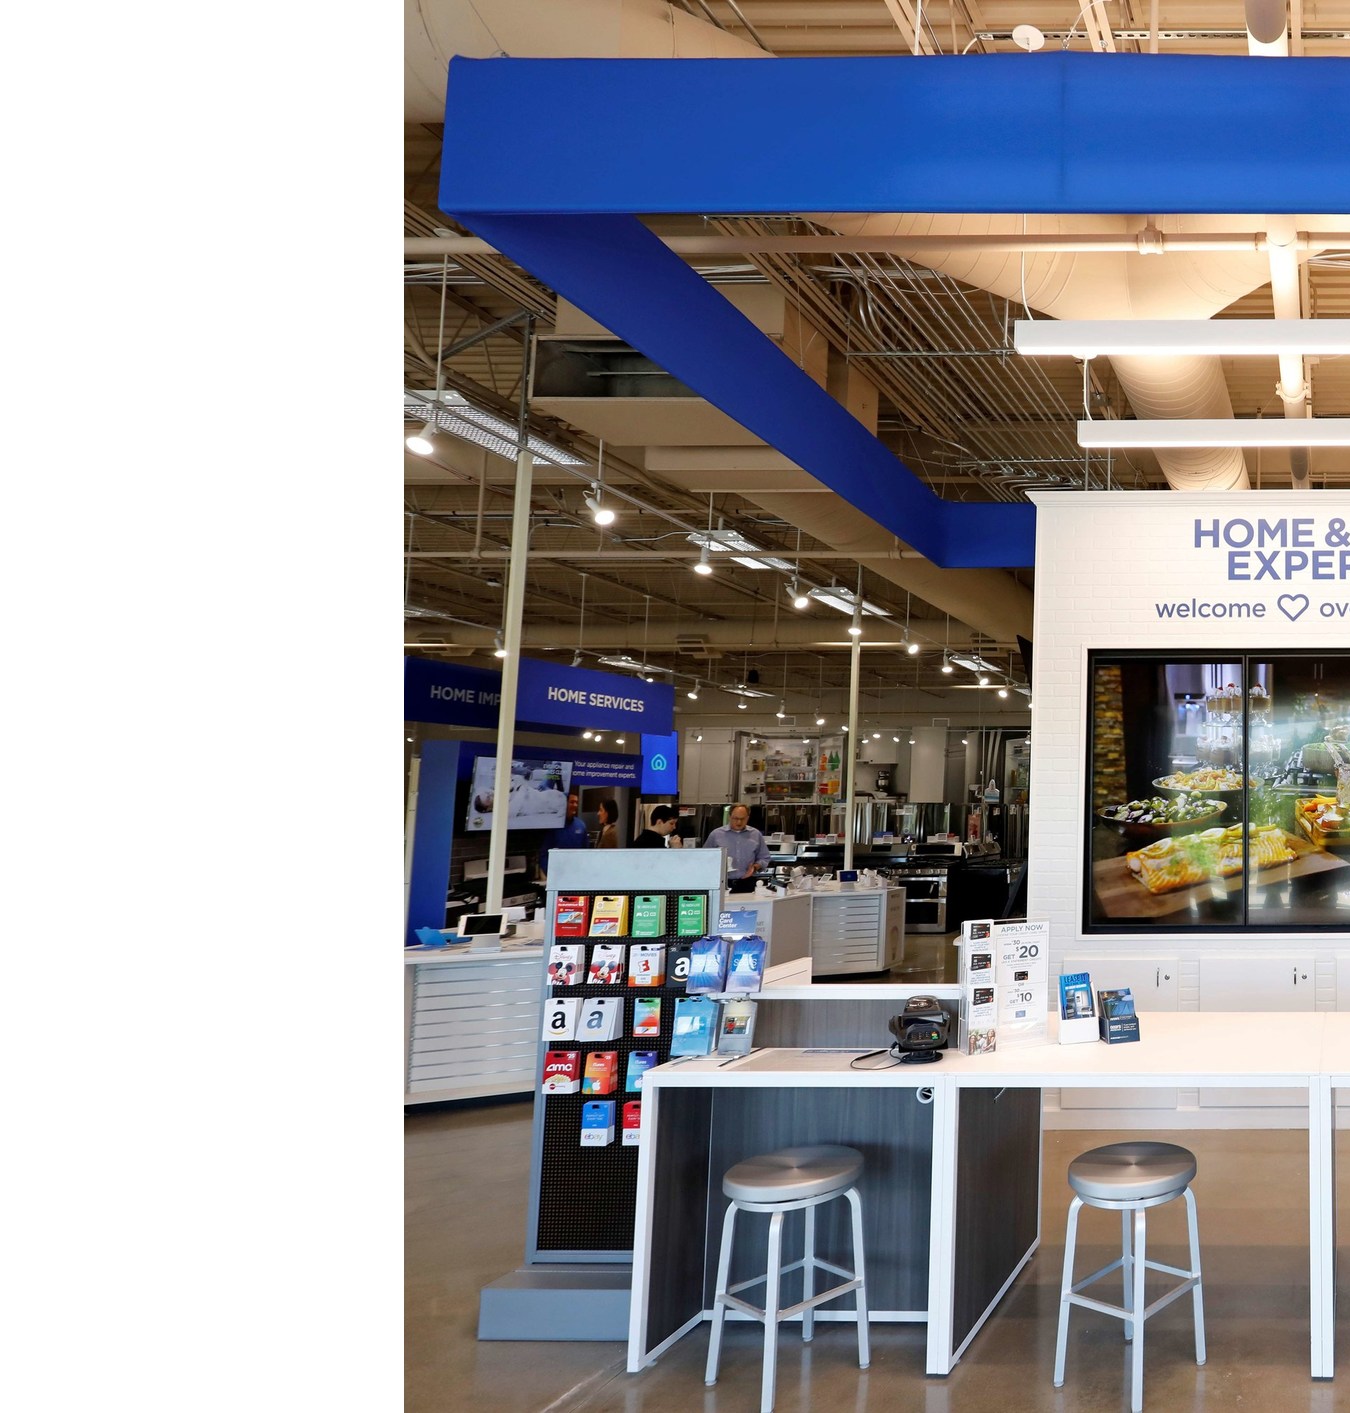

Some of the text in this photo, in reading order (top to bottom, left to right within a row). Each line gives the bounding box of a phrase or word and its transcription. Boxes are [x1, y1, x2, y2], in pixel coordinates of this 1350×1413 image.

[1194, 518, 1315, 548] HOME
[1325, 518, 1350, 548] &
[1155, 598, 1266, 618] welcome
[430, 685, 474, 704] HOME
[548, 686, 645, 713] HOME SERVICES
[574, 760, 587, 769] Your
[587, 762, 610, 771] appliance
[611, 762, 624, 771] repair
[586, 771, 618, 779] improvement
[1016, 945, 1039, 959] $20
[674, 956, 690, 976] a
[1017, 992, 1032, 1002] $10
[552, 1011, 566, 1029] a
[587, 1011, 604, 1029] a
[546, 1064, 573, 1072] amc
[625, 1132, 641, 1140] eba
